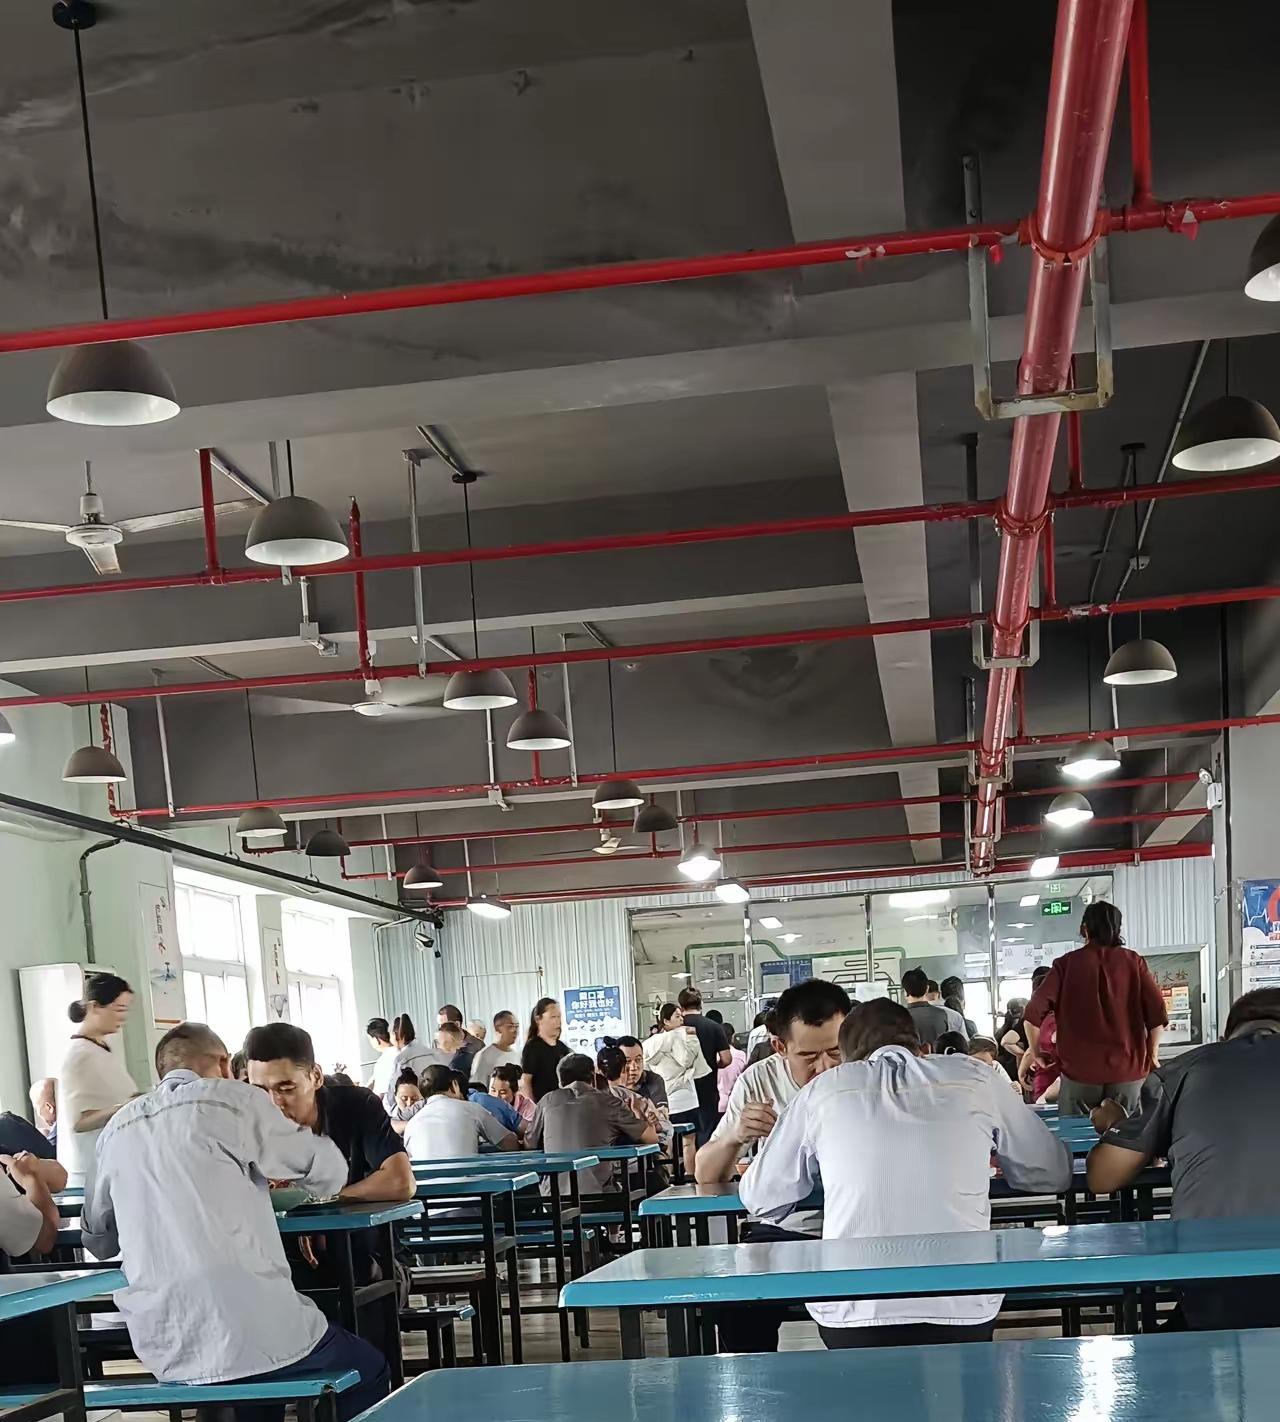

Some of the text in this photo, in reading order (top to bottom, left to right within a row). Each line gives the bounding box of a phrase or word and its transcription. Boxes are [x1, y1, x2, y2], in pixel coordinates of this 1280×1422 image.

[571, 998, 615, 1010] 你好我也好
